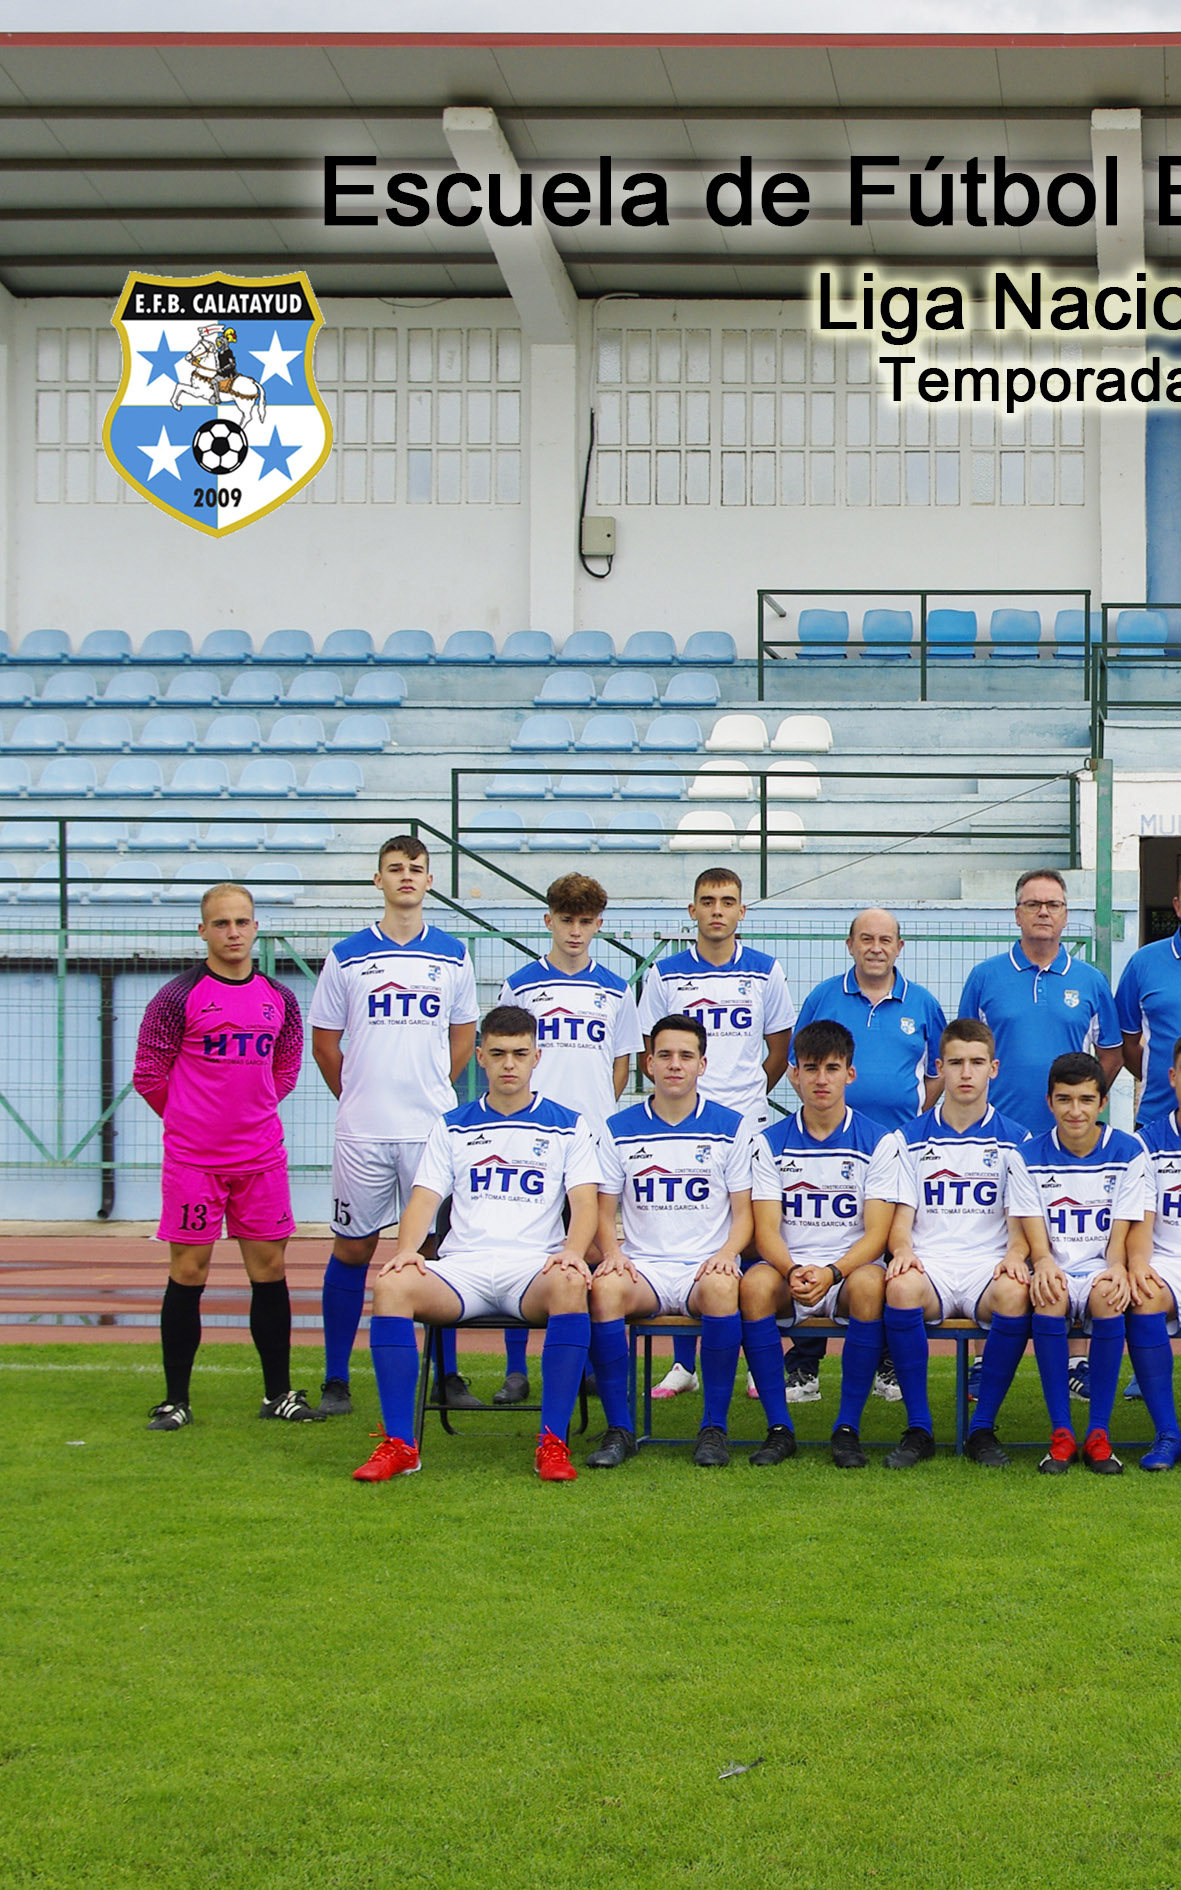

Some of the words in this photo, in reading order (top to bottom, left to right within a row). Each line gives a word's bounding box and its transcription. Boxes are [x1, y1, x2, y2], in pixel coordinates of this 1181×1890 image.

[369, 994, 440, 1017] HTG
[538, 1018, 605, 1042] HTG
[203, 1033, 273, 1056] HTG
[470, 1168, 544, 1195] HTG
[633, 1177, 709, 1202] HTG
[924, 1181, 997, 1206] HTG
[178, 1203, 208, 1231] 13
[333, 1198, 351, 1227] 15
[782, 1192, 857, 1218] HTG
[1047, 1208, 1110, 1233] HTG
